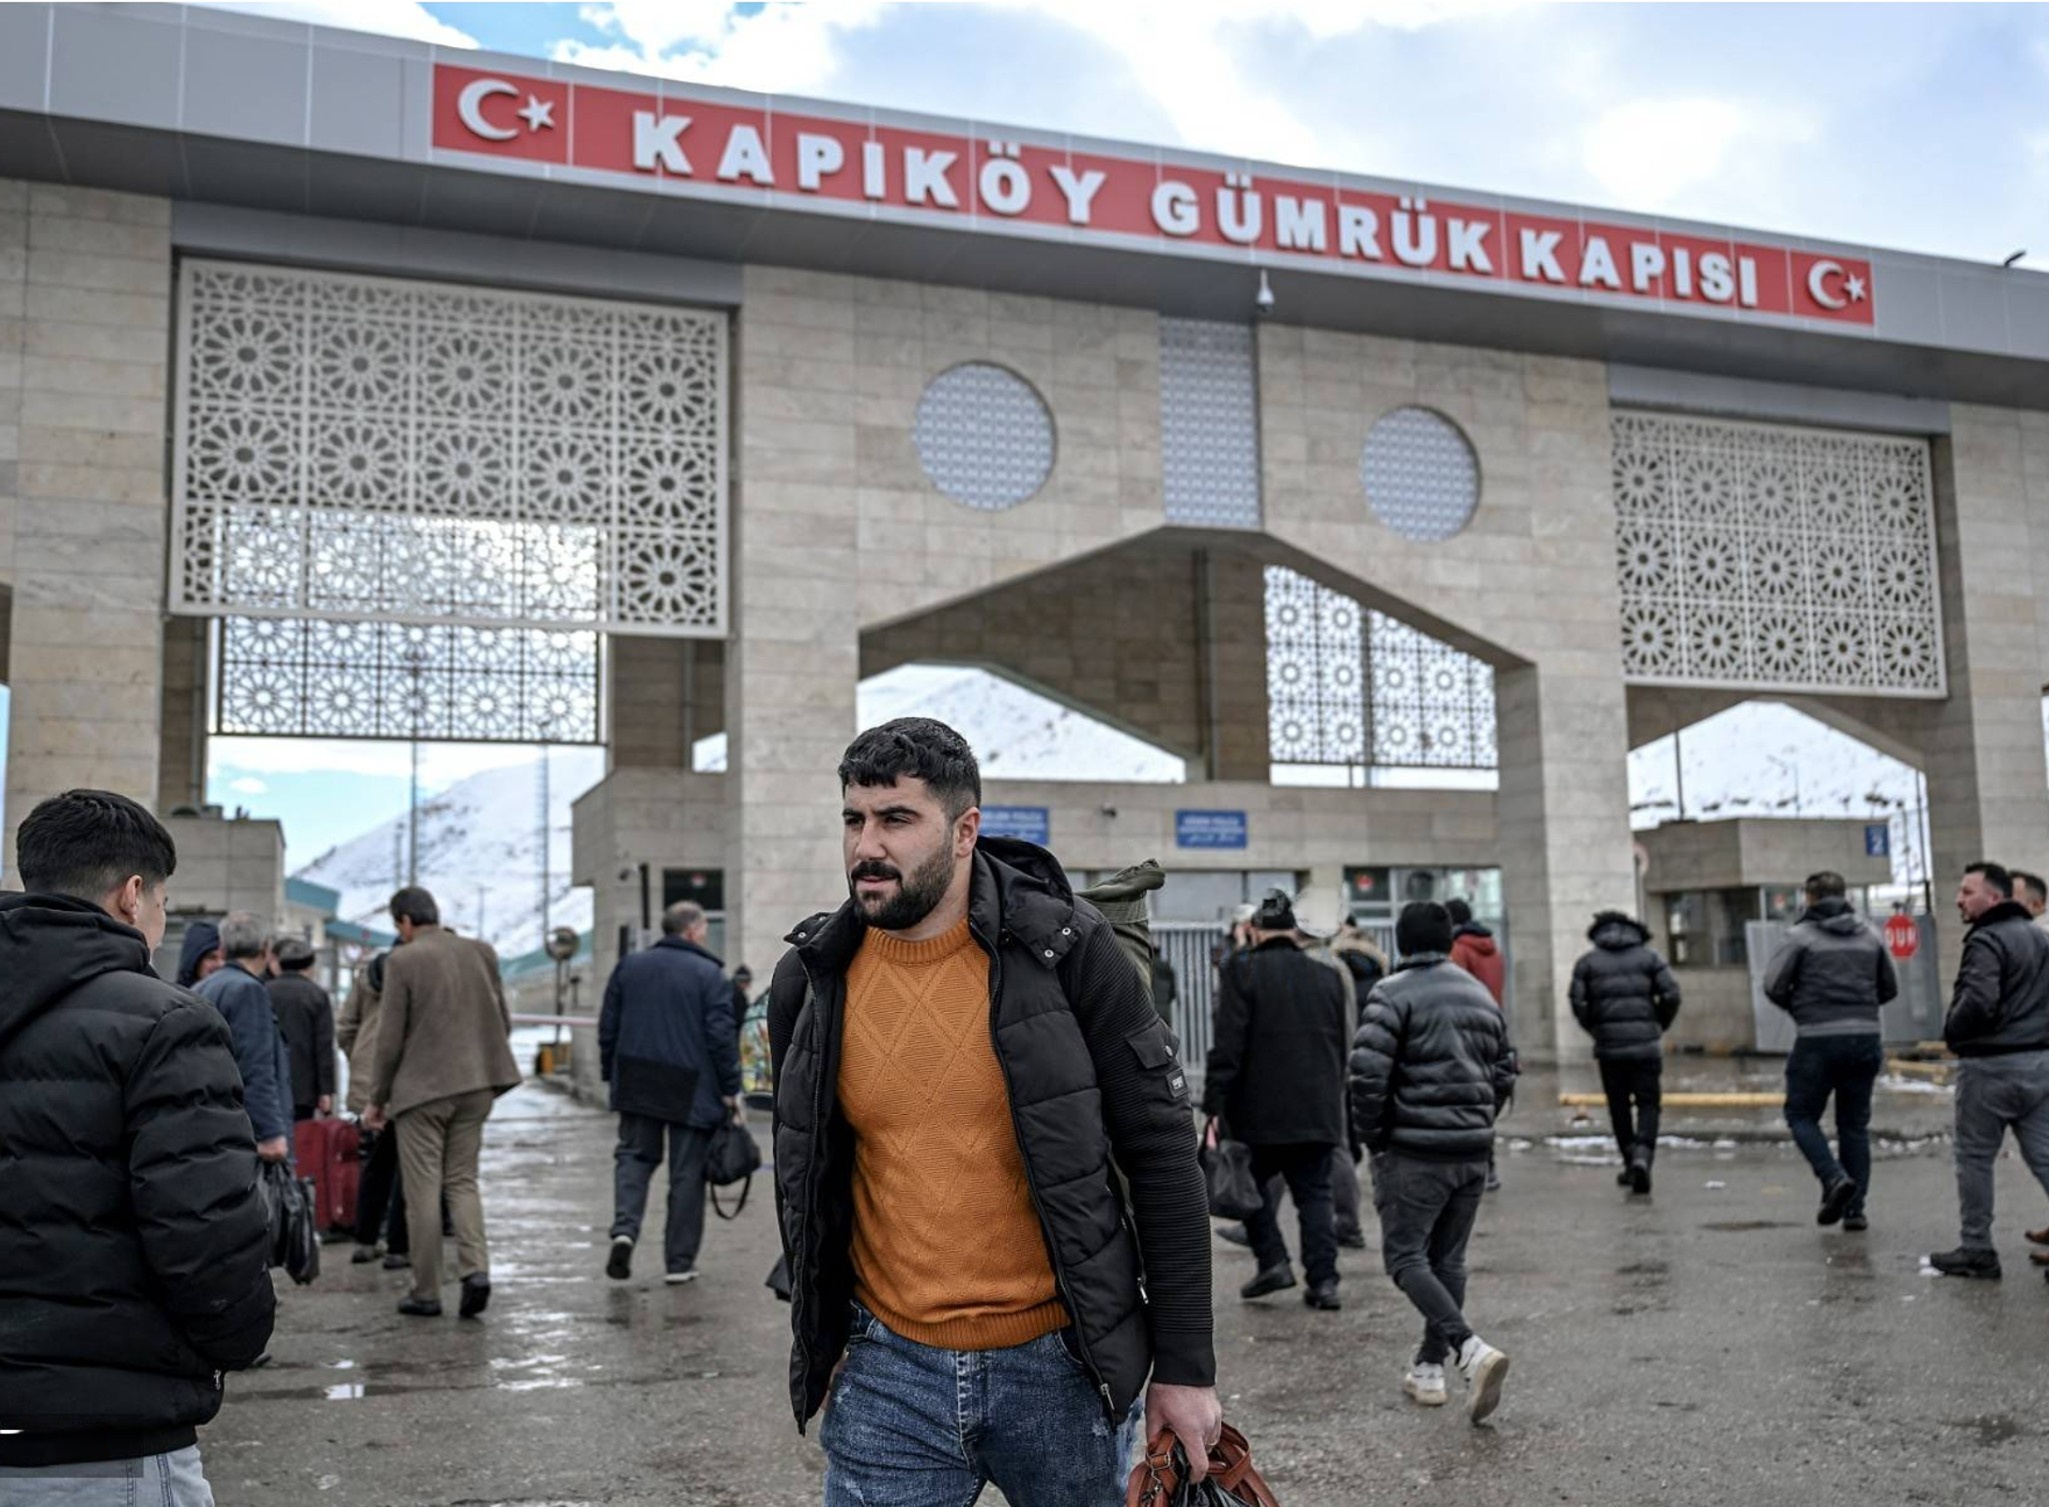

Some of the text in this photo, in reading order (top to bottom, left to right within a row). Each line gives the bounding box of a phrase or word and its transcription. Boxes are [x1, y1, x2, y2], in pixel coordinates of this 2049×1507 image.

[632, 110, 1758, 307] KAPIKÖY GÜMRÜK KAPISI
